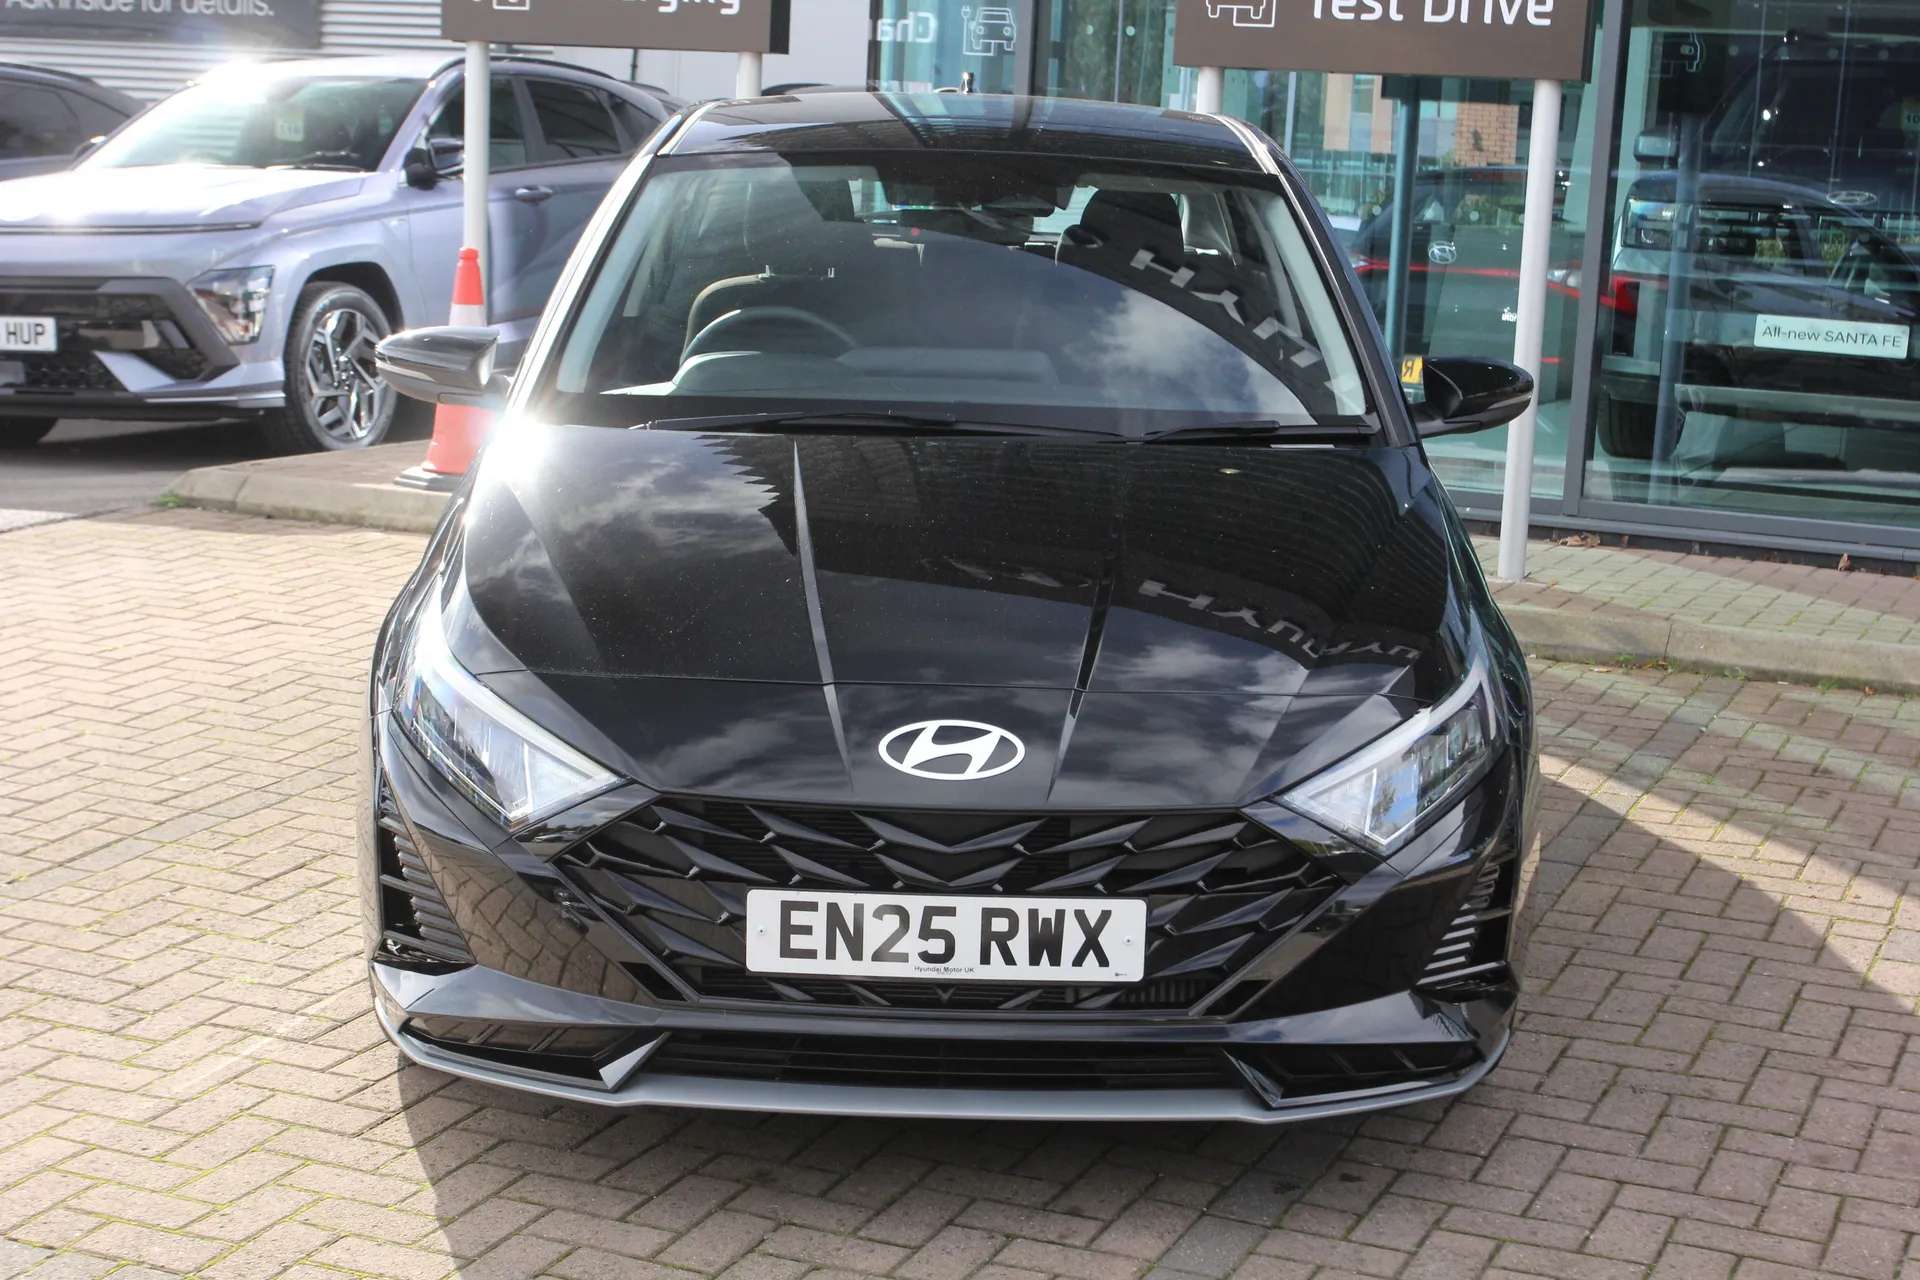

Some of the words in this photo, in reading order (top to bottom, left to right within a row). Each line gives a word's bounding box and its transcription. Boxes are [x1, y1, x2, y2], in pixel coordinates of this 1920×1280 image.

[1424, 0, 1554, 26] Drive
[5, 322, 46, 345] HUP
[1762, 325, 1820, 342] All-new
[1823, 330, 1878, 347] SANTA
[1882, 335, 1903, 348] FE
[779, 900, 957, 964] EN25
[980, 907, 1112, 968] RWX
[943, 966, 962, 974] Motor
